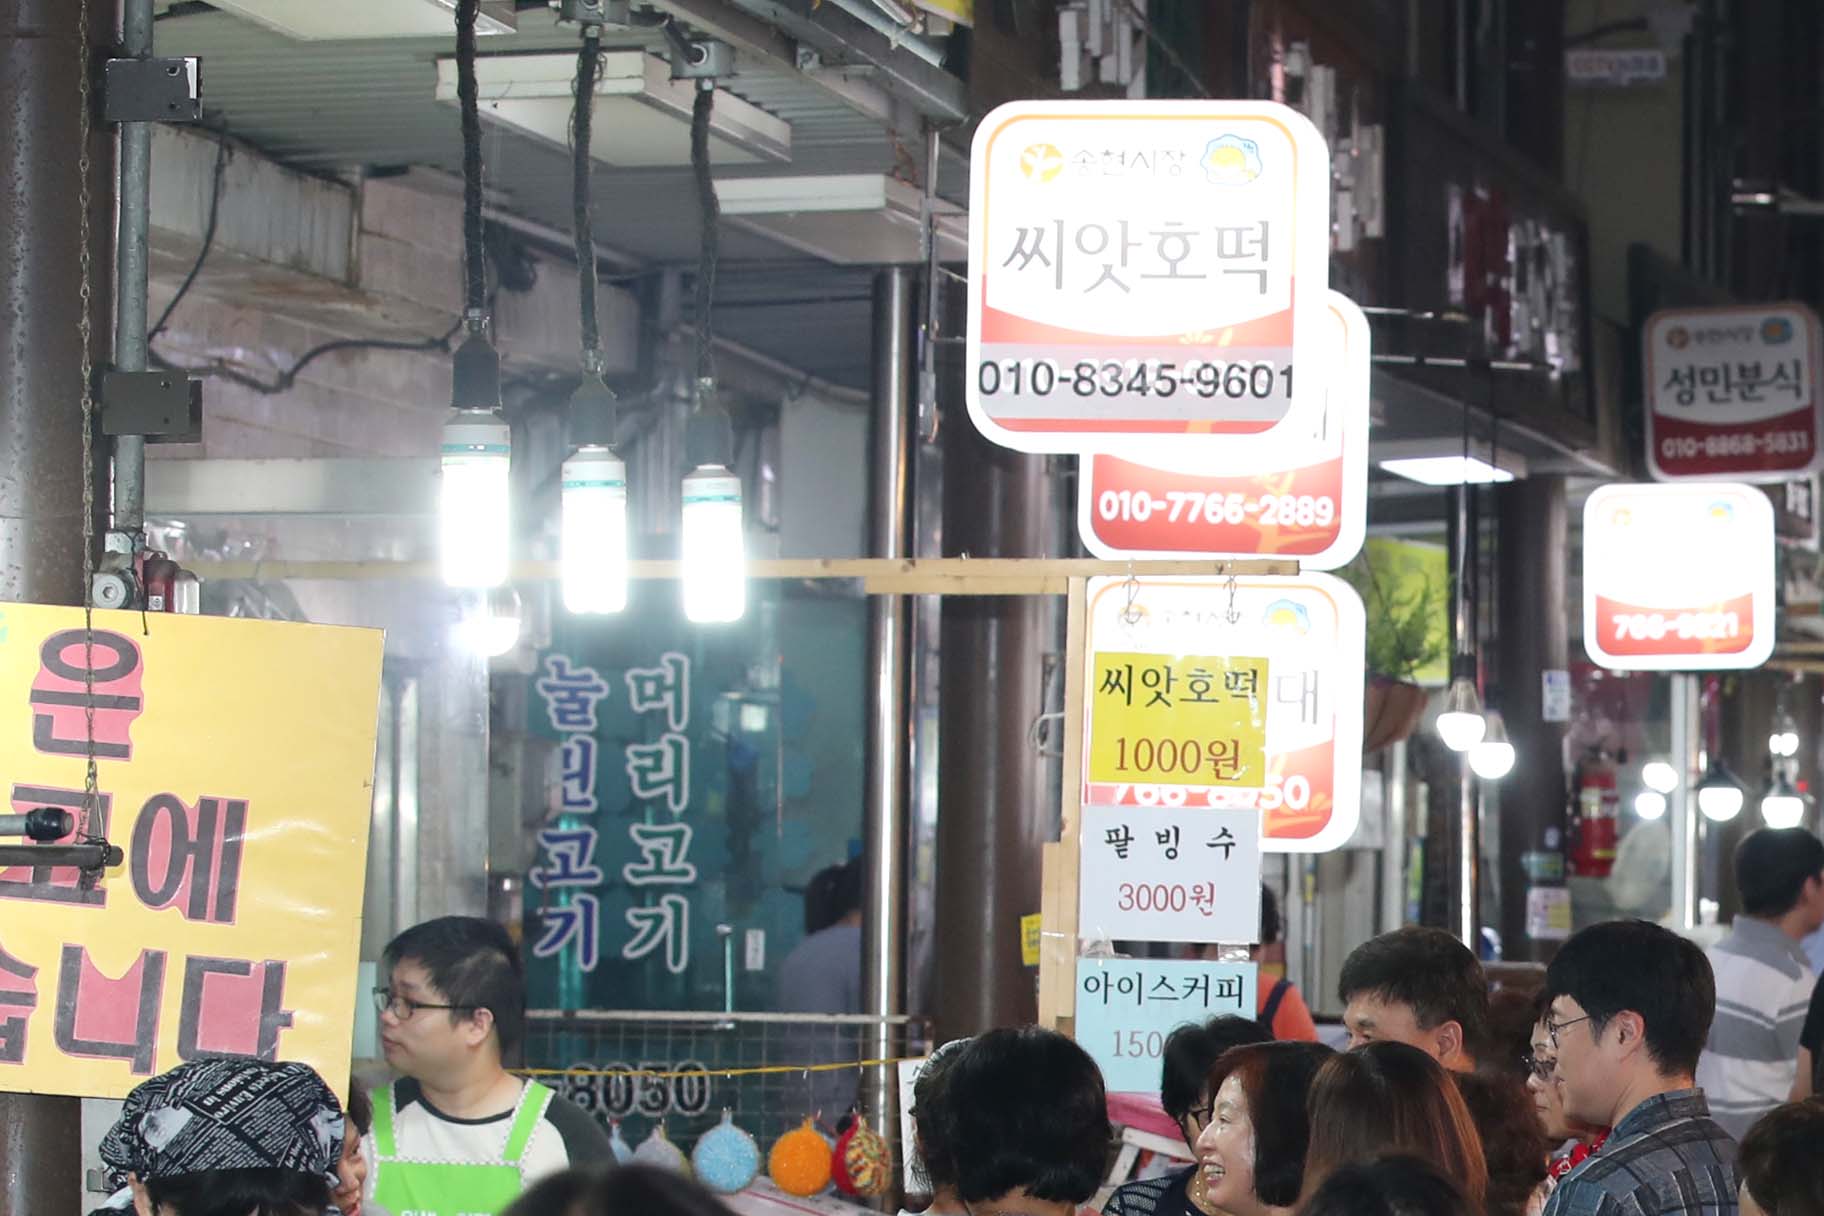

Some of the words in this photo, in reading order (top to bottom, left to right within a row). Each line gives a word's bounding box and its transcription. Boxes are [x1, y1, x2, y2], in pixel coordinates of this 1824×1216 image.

[1072, 146, 1186, 177] 송현시장
[1002, 220, 1271, 294] 씨앗호떡
[979, 361, 1294, 398] 010-8345-9601
[1664, 358, 1803, 406] 성민분식
[1099, 664, 1259, 709] 씨앗호떡
[1114, 738, 1242, 781] 1000원
[531, 653, 608, 972] 눌린고기
[623, 652, 697, 973] 머리고기
[1118, 882, 1216, 917] 3000원
[1083, 971, 1244, 1008] 아이스커피
